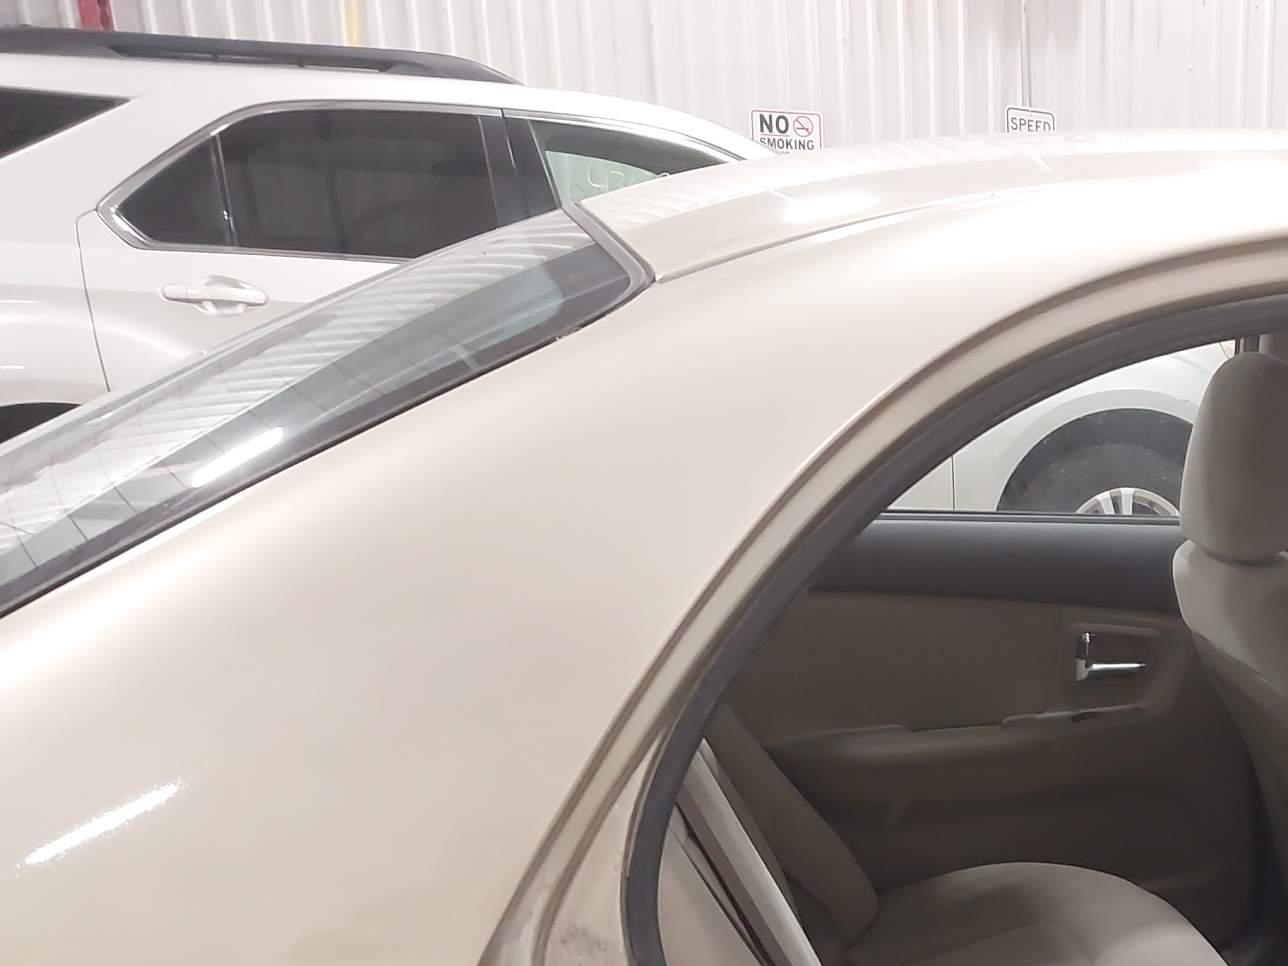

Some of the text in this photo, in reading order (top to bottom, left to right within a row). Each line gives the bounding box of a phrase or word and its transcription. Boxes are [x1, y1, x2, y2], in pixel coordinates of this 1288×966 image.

[759, 113, 790, 135] NO
[1010, 117, 1051, 133] SPEED
[759, 137, 815, 151] SMOKING
